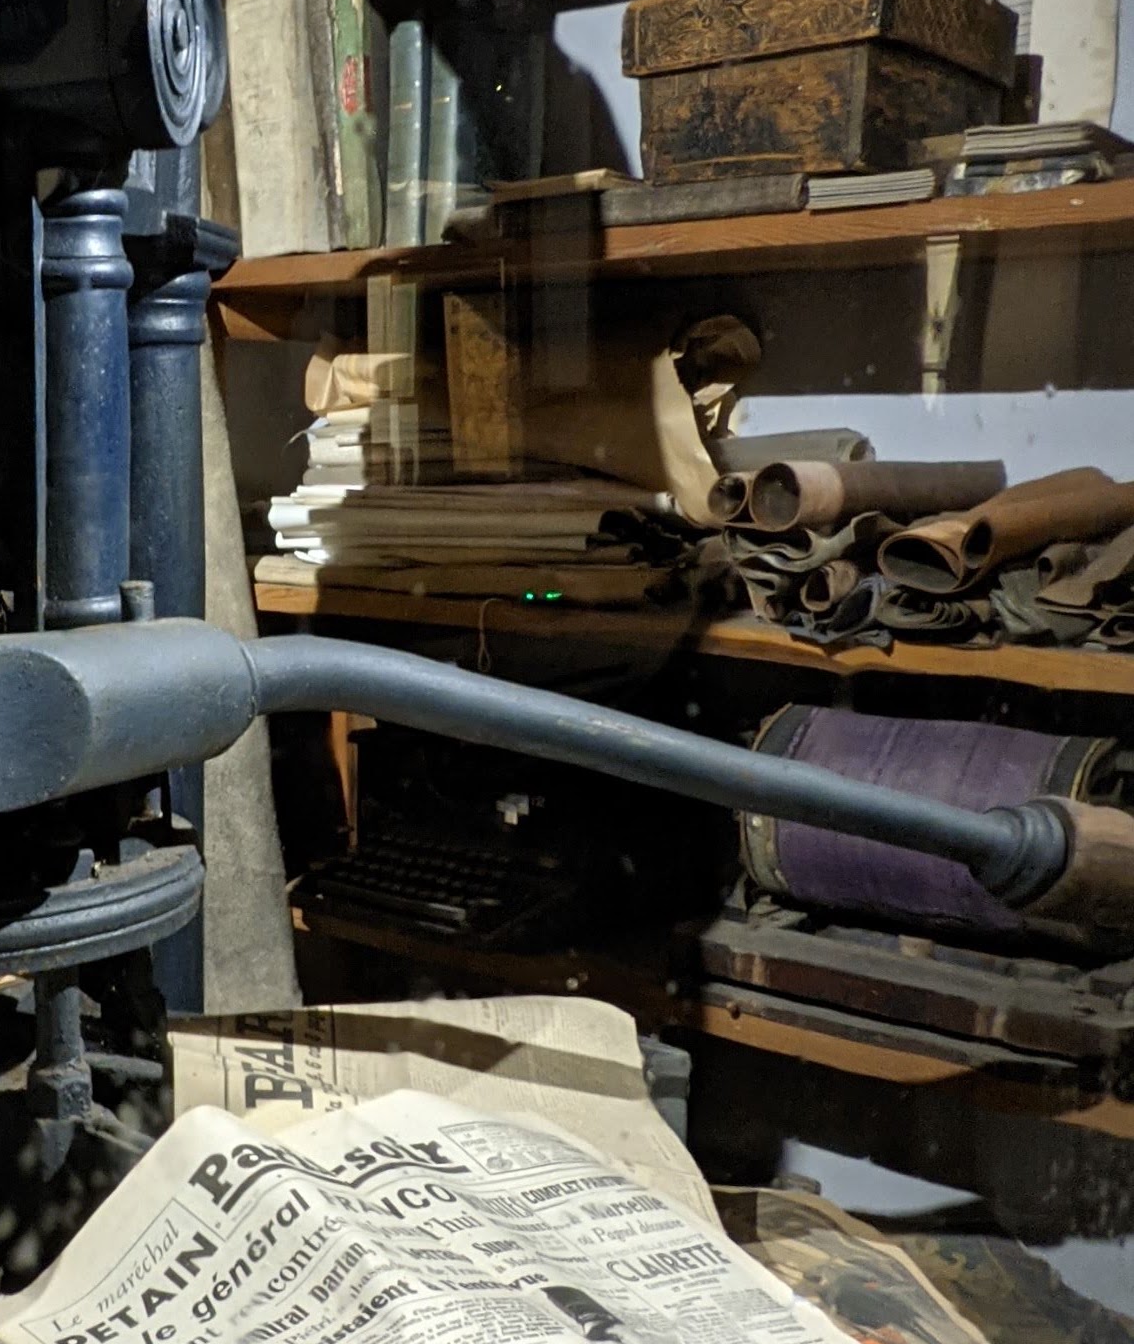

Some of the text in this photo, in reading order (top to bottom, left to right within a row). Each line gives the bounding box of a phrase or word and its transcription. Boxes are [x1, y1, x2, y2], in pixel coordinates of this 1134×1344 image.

[52, 1218, 179, 1332] Le maréchal
[192, 1188, 311, 1324] général
[229, 1215, 344, 1325] rencontré
[606, 1241, 732, 1284] CLAIRETTE
